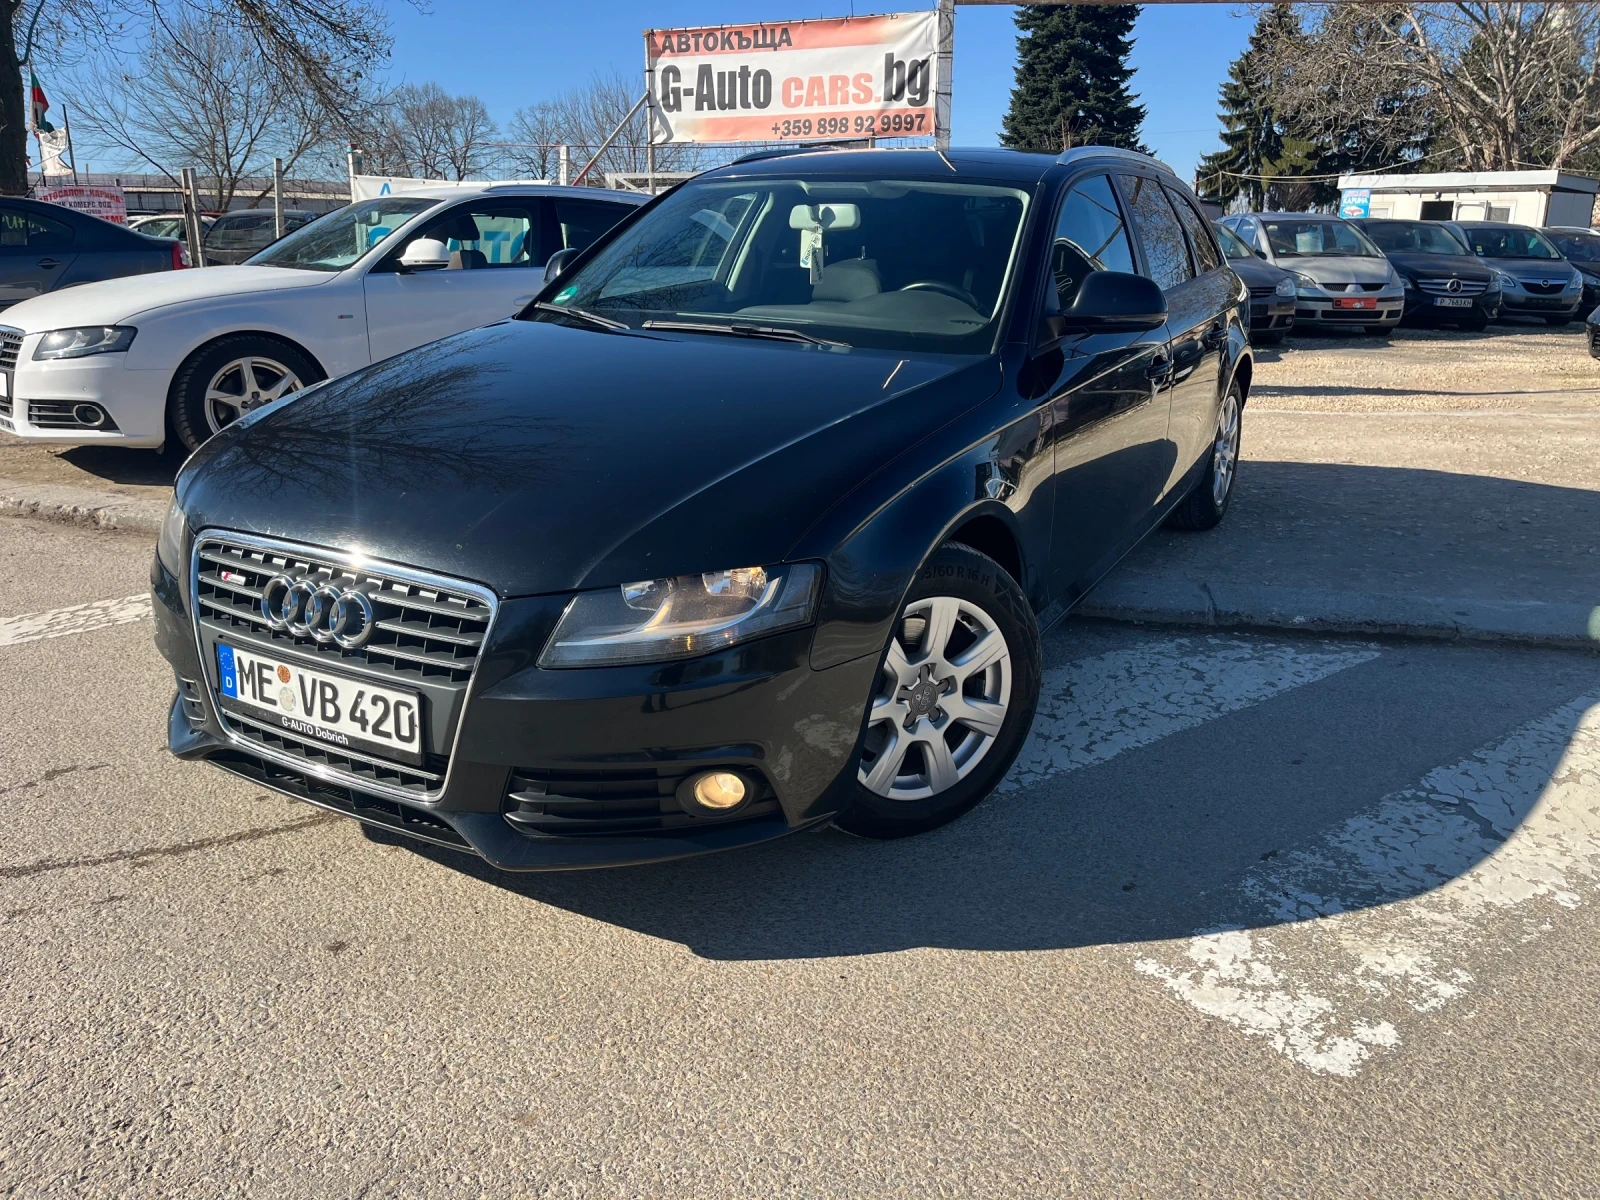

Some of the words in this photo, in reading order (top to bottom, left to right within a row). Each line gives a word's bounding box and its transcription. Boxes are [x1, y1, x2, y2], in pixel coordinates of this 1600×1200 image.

[661, 27, 793, 54] АВТОКЪЩА
[660, 63, 773, 113] G-Auto
[771, 118, 812, 137] +359
[816, 116, 849, 135] 898
[854, 115, 875, 133] 92
[881, 113, 926, 132] 9997
[225, 676, 233, 689] D
[237, 655, 278, 706] ME
[298, 673, 342, 725] VB
[349, 690, 418, 744] 420
[281, 716, 314, 735] G-AUTO
[315, 724, 349, 746] Dobrich
